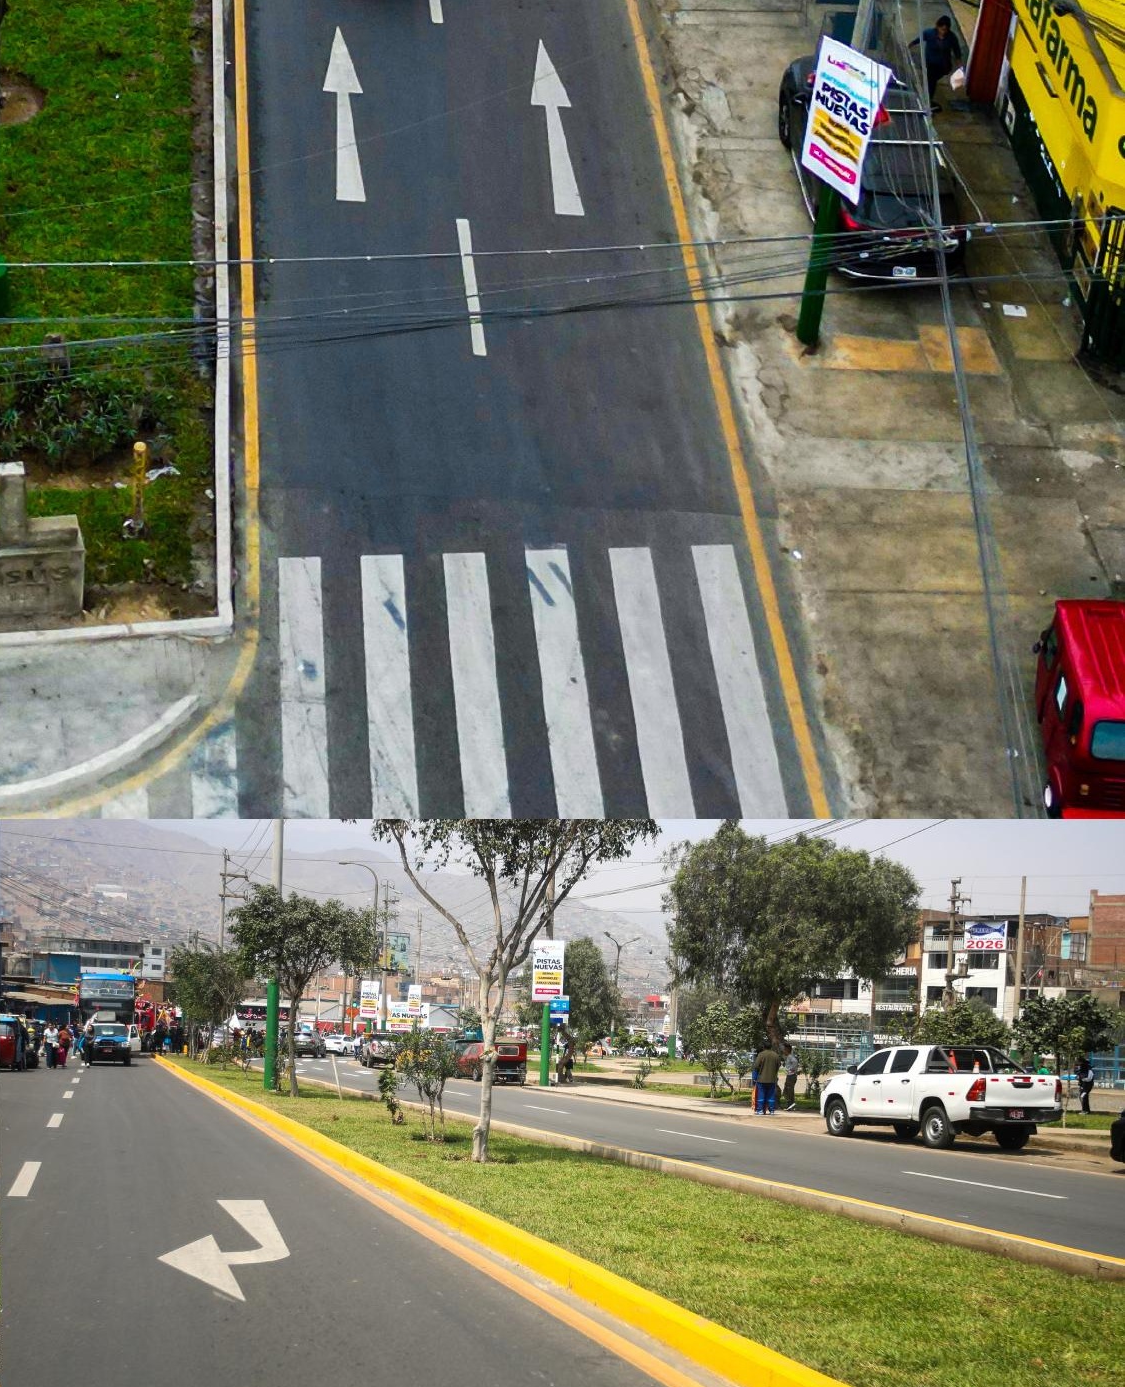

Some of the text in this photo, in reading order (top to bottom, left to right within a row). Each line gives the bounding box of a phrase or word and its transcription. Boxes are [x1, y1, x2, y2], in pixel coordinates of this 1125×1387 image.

[815, 91, 871, 136] NUEVAS
[821, 82, 868, 120] PISTAS
[966, 940, 1004, 949] 2026
